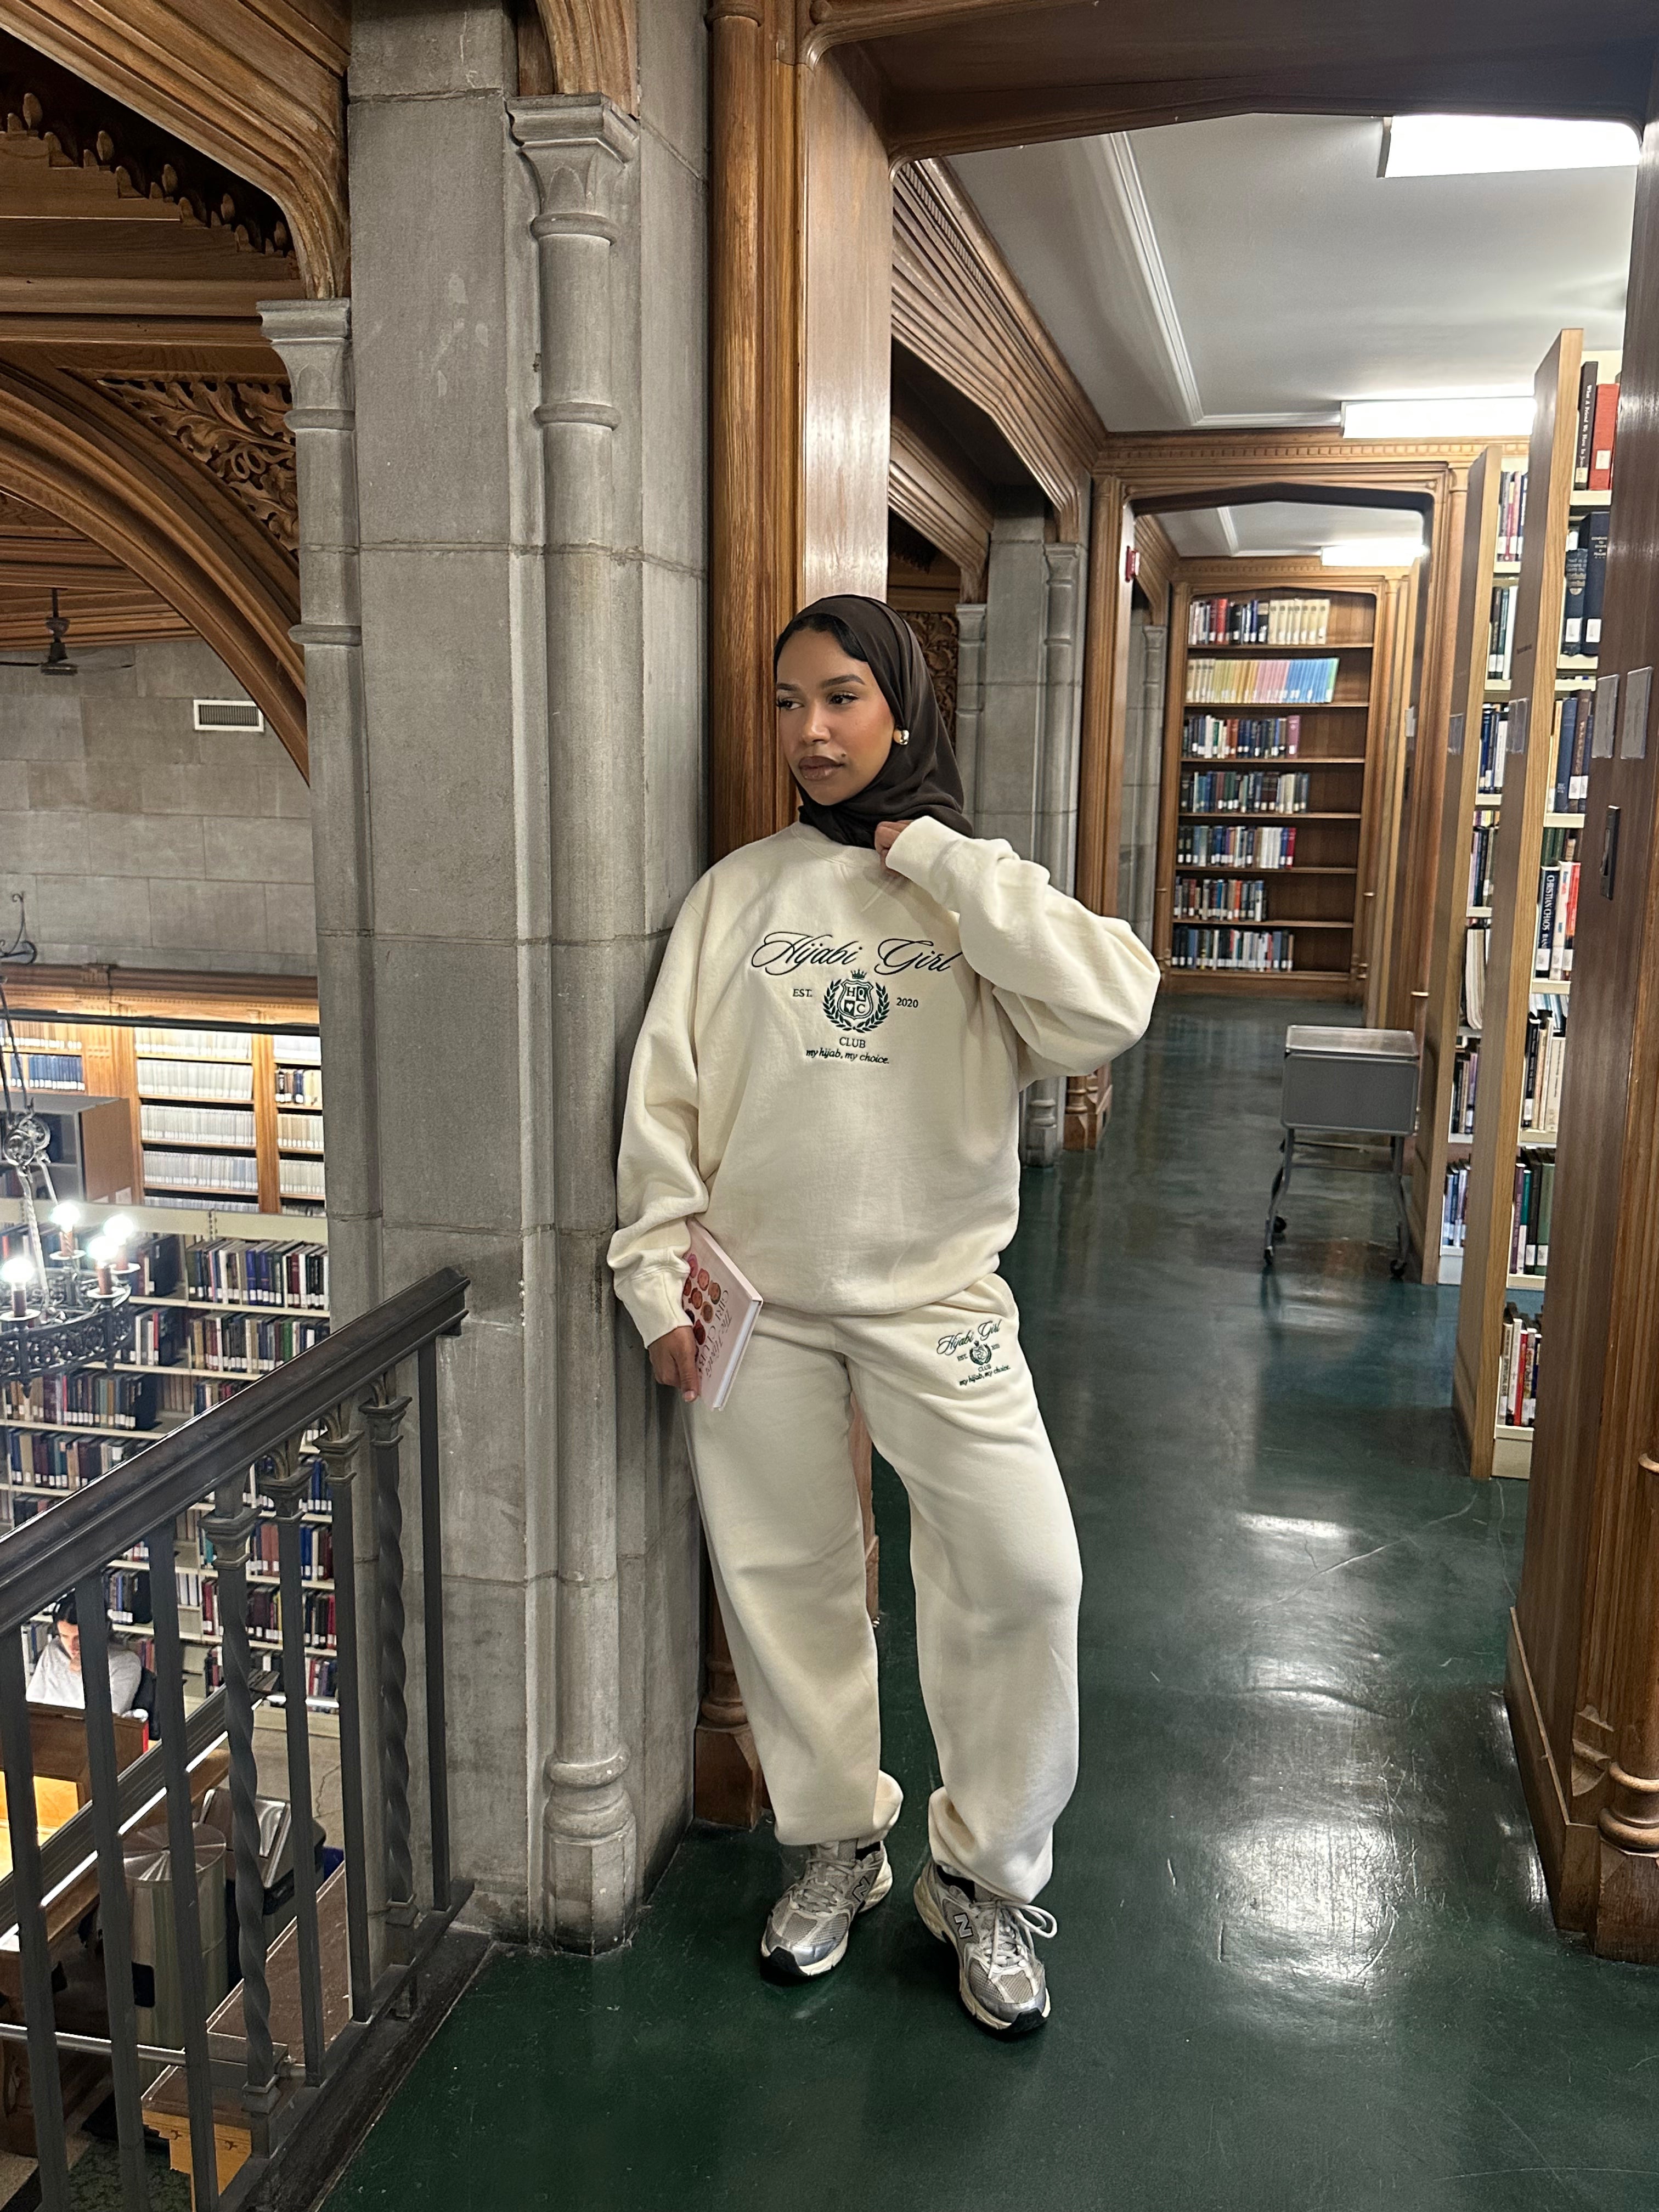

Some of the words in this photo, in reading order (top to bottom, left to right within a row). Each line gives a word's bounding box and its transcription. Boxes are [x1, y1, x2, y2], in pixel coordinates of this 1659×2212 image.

[1545, 874, 1555, 908] CHRISTIAN
[1542, 908, 1551, 931] CHAOS
[751, 931, 862, 975] Hijabi
[874, 938, 963, 975] Girl
[792, 988, 812, 997] EST.
[847, 986, 856, 997] H
[896, 997, 919, 1008] 2020
[856, 1003, 866, 1014] C
[839, 1036, 866, 1048] CLUB
[806, 1048, 819, 1057] my
[819, 1047, 844, 1059] hijab,
[845, 1052, 858, 1060] my
[859, 1053, 890, 1064] choice.
[715, 1289, 729, 1323] GIRL
[699, 1325, 716, 1366] CLUB
[936, 1330, 974, 1356] Hijabi
[978, 1319, 1002, 1341] Girl
[953, 1912, 974, 1939] N
